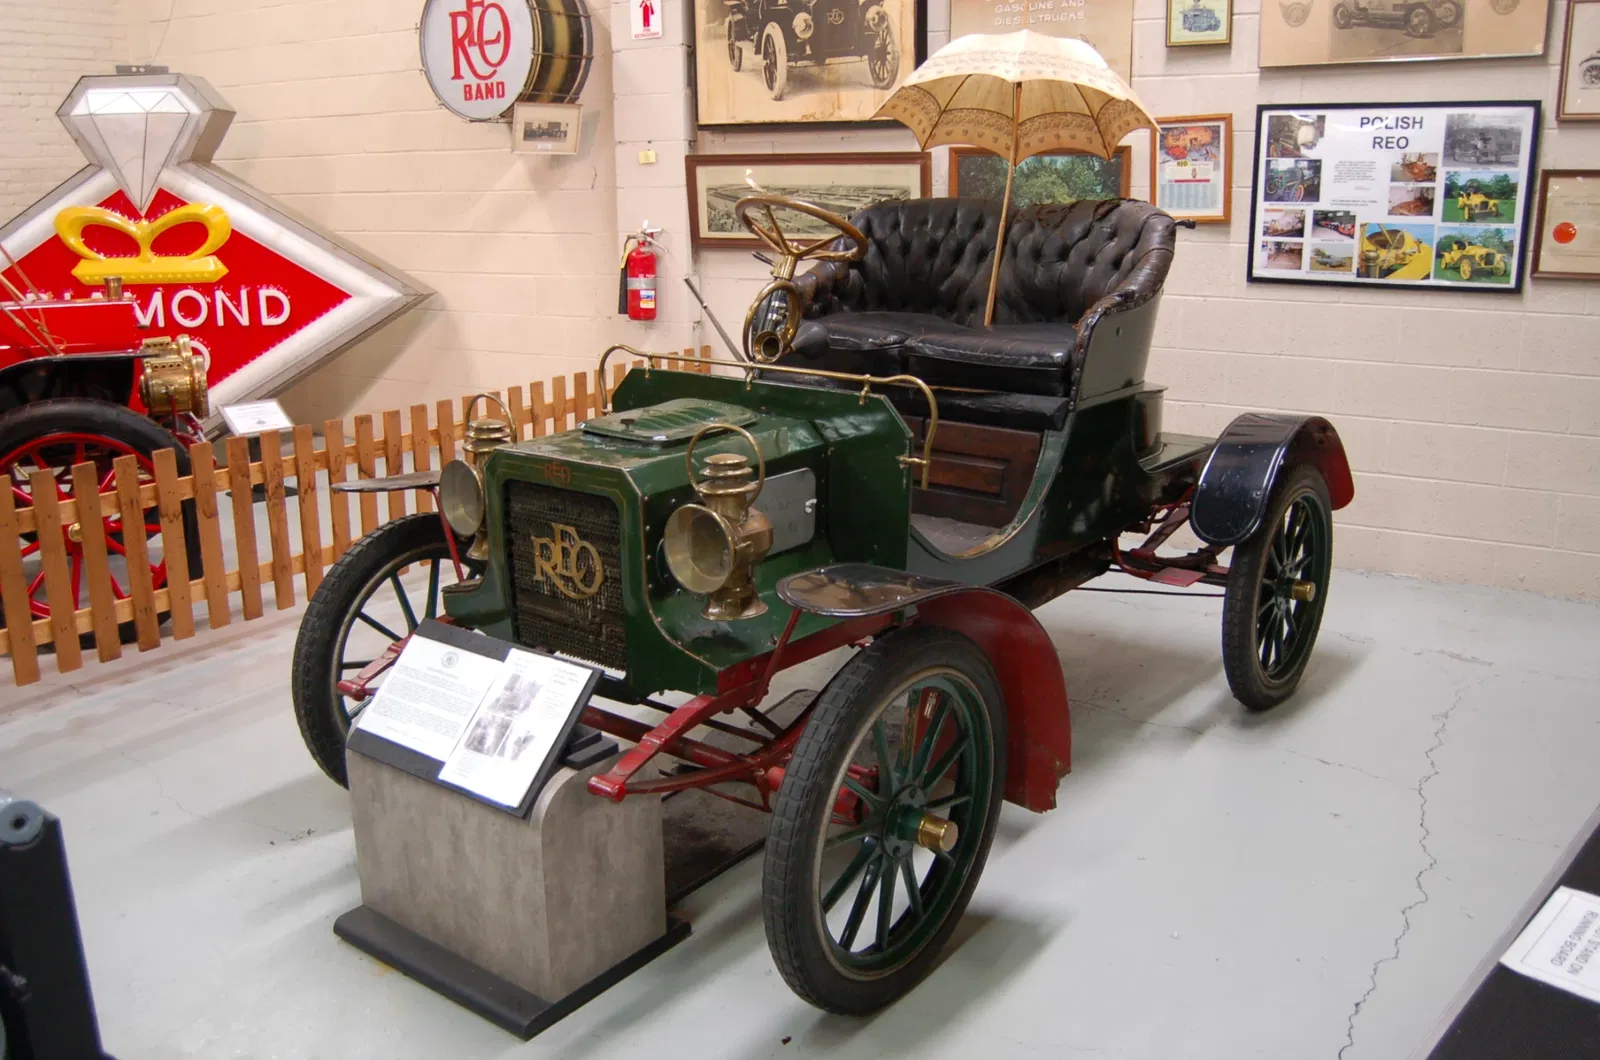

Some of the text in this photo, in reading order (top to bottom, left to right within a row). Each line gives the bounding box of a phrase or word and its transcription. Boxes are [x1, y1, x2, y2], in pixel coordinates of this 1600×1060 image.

[1039, 11, 1085, 22] TRUCKS
[463, 81, 505, 101] BAND
[1360, 116, 1424, 130] POLISH
[1372, 136, 1409, 149] REO
[531, 523, 603, 599] REO
